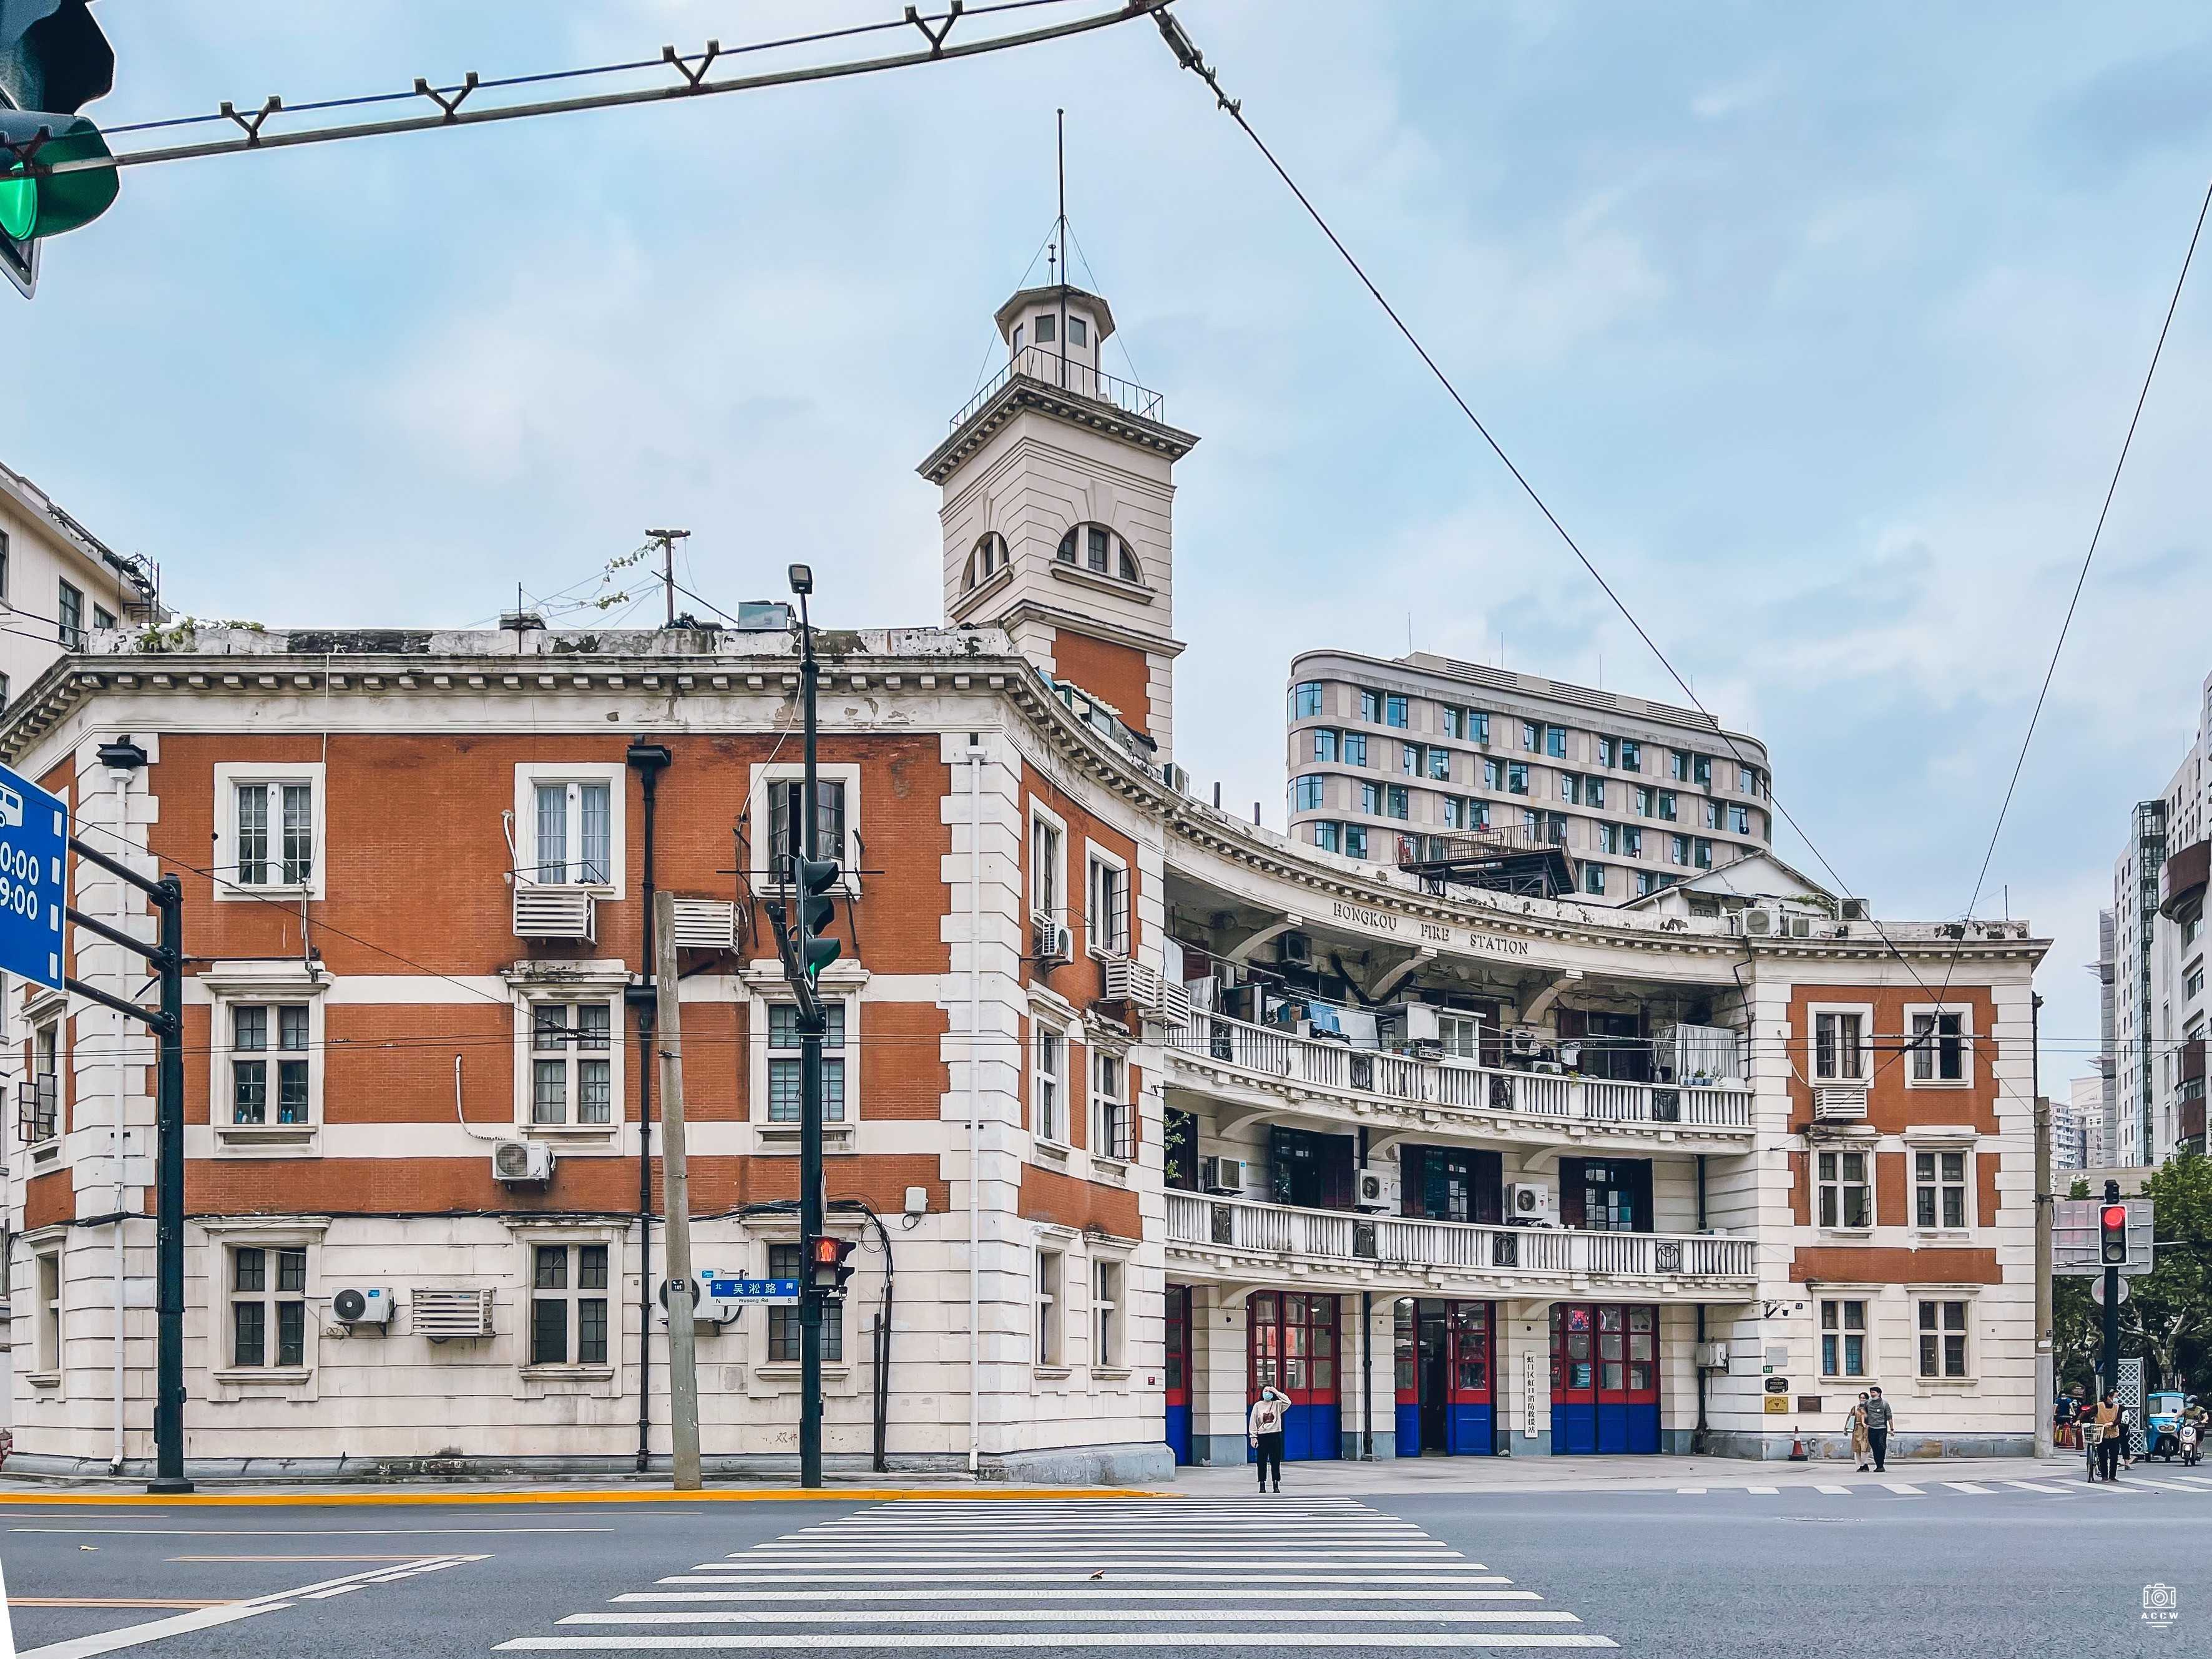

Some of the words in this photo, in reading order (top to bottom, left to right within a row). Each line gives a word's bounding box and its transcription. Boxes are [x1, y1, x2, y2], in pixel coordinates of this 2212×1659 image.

[1333, 902, 1397, 931] HONGKOU
[1421, 923, 1450, 942] FIRE
[1470, 934, 1529, 955] STATION
[733, 1283, 776, 1294] 吴淞路
